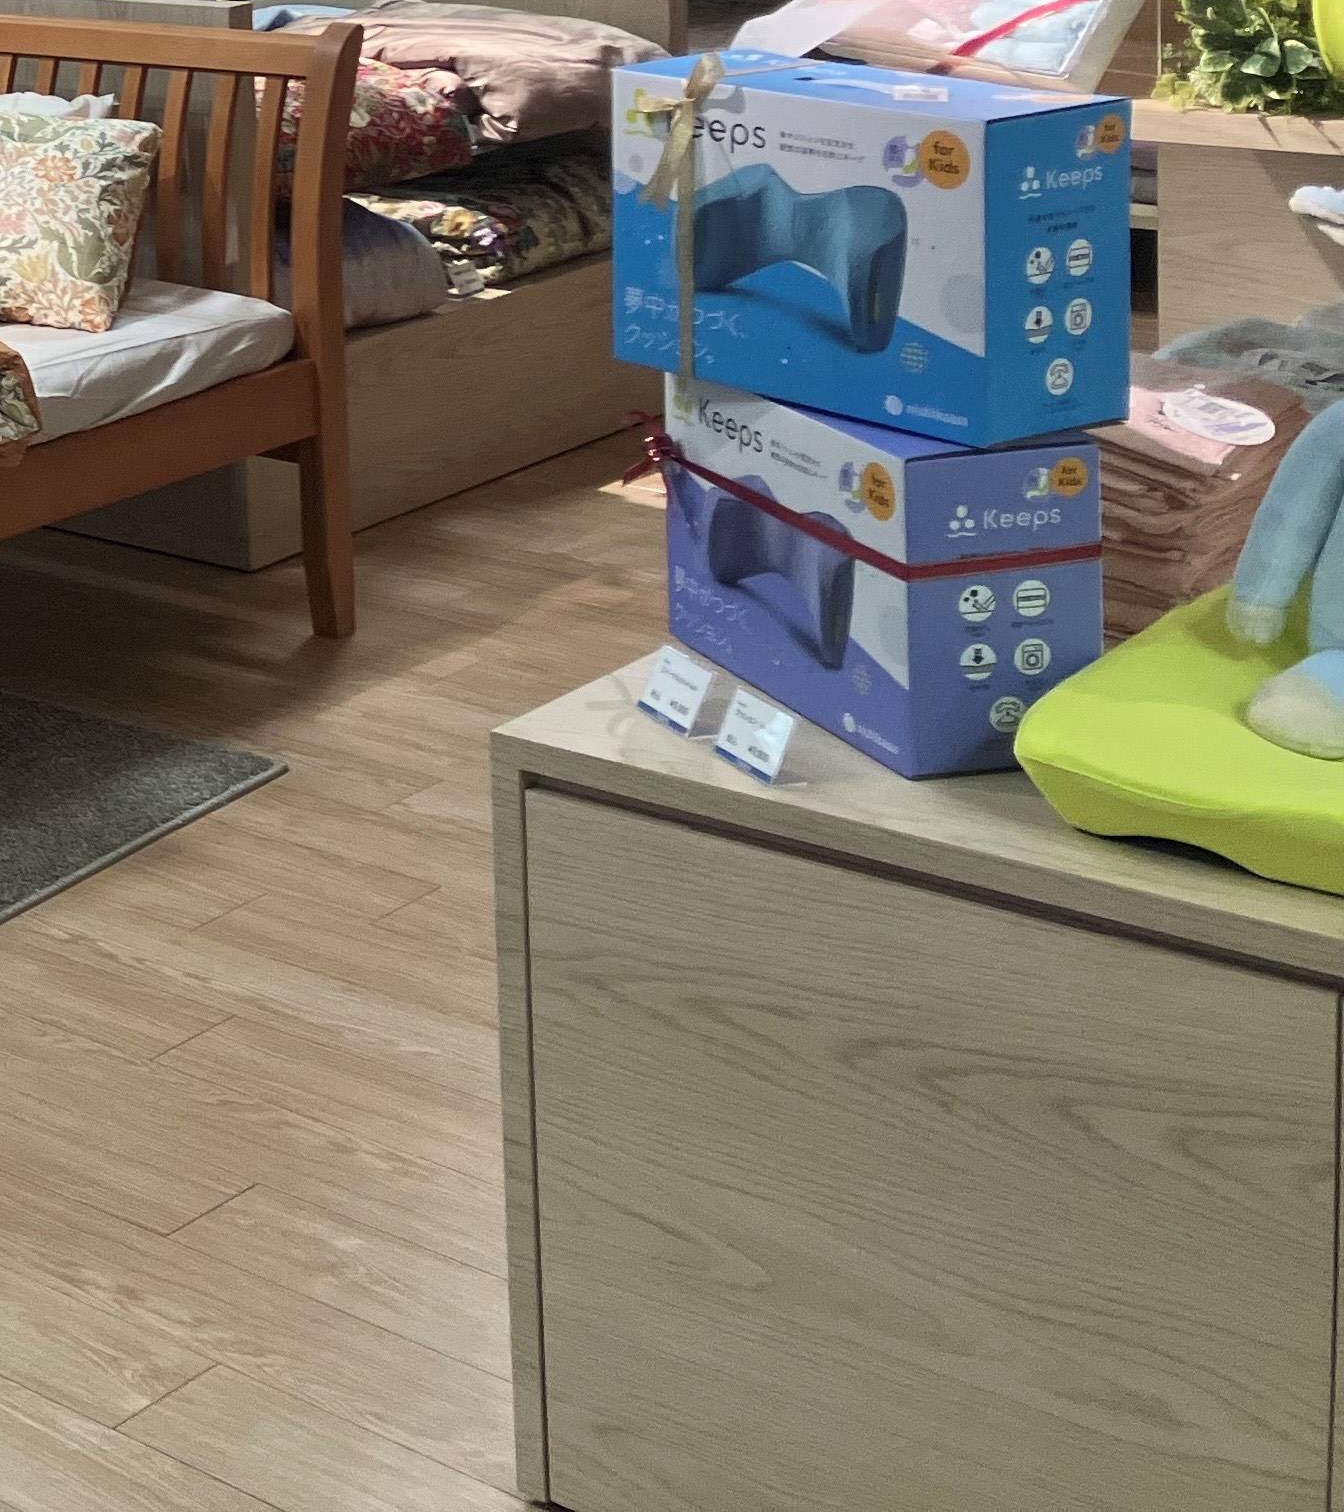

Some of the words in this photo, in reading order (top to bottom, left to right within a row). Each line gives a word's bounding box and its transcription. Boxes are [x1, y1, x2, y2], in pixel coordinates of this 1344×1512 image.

[666, 109, 767, 154] eeps
[927, 157, 961, 175] Kids
[1045, 165, 1104, 189] Keeps
[697, 397, 764, 454] Keeps
[983, 507, 1062, 532] Keeps
